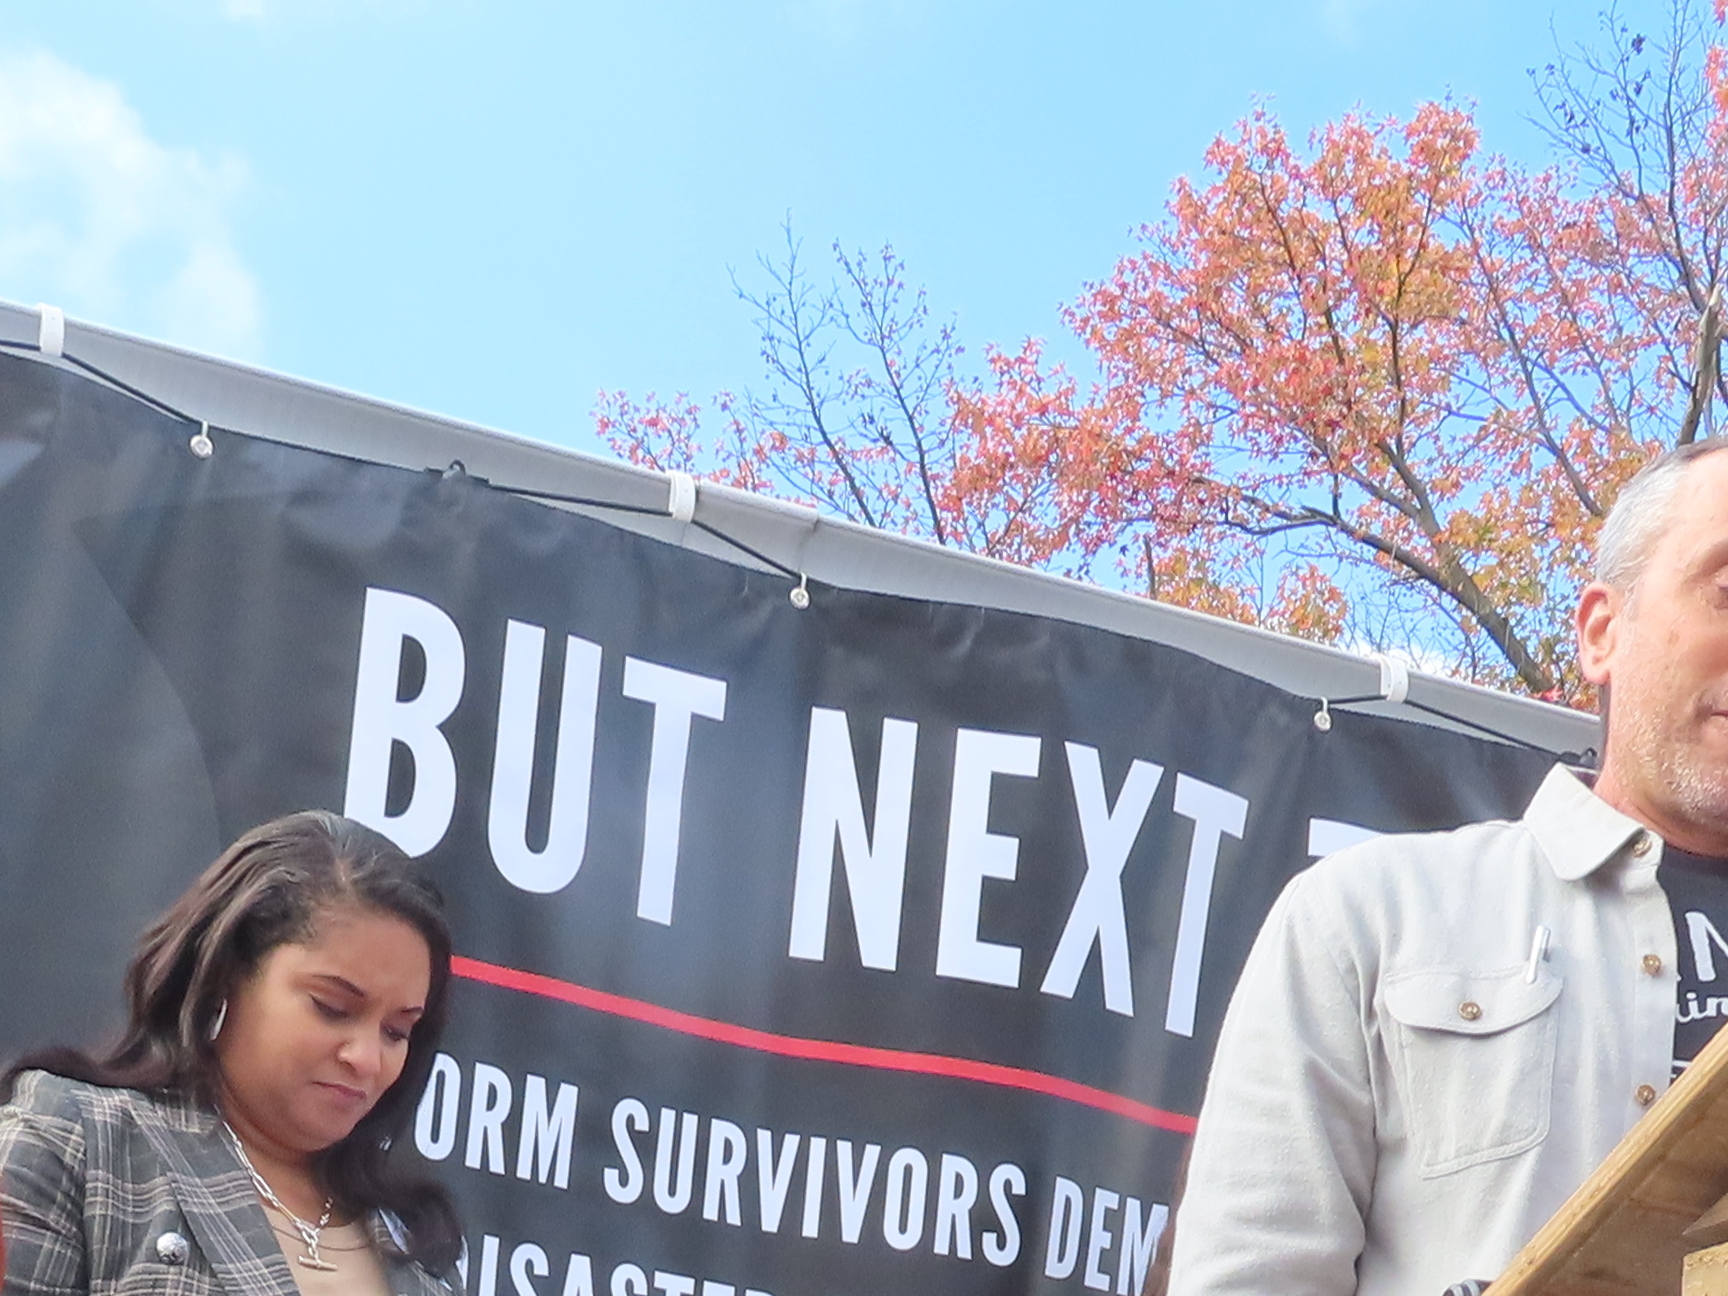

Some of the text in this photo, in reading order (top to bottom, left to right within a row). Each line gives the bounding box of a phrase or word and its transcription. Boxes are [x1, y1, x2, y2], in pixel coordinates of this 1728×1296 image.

[343, 587, 1249, 1038] BUT NEXT
[414, 1052, 579, 1190] ORM
[602, 1097, 1027, 1267] SURVIVORS
